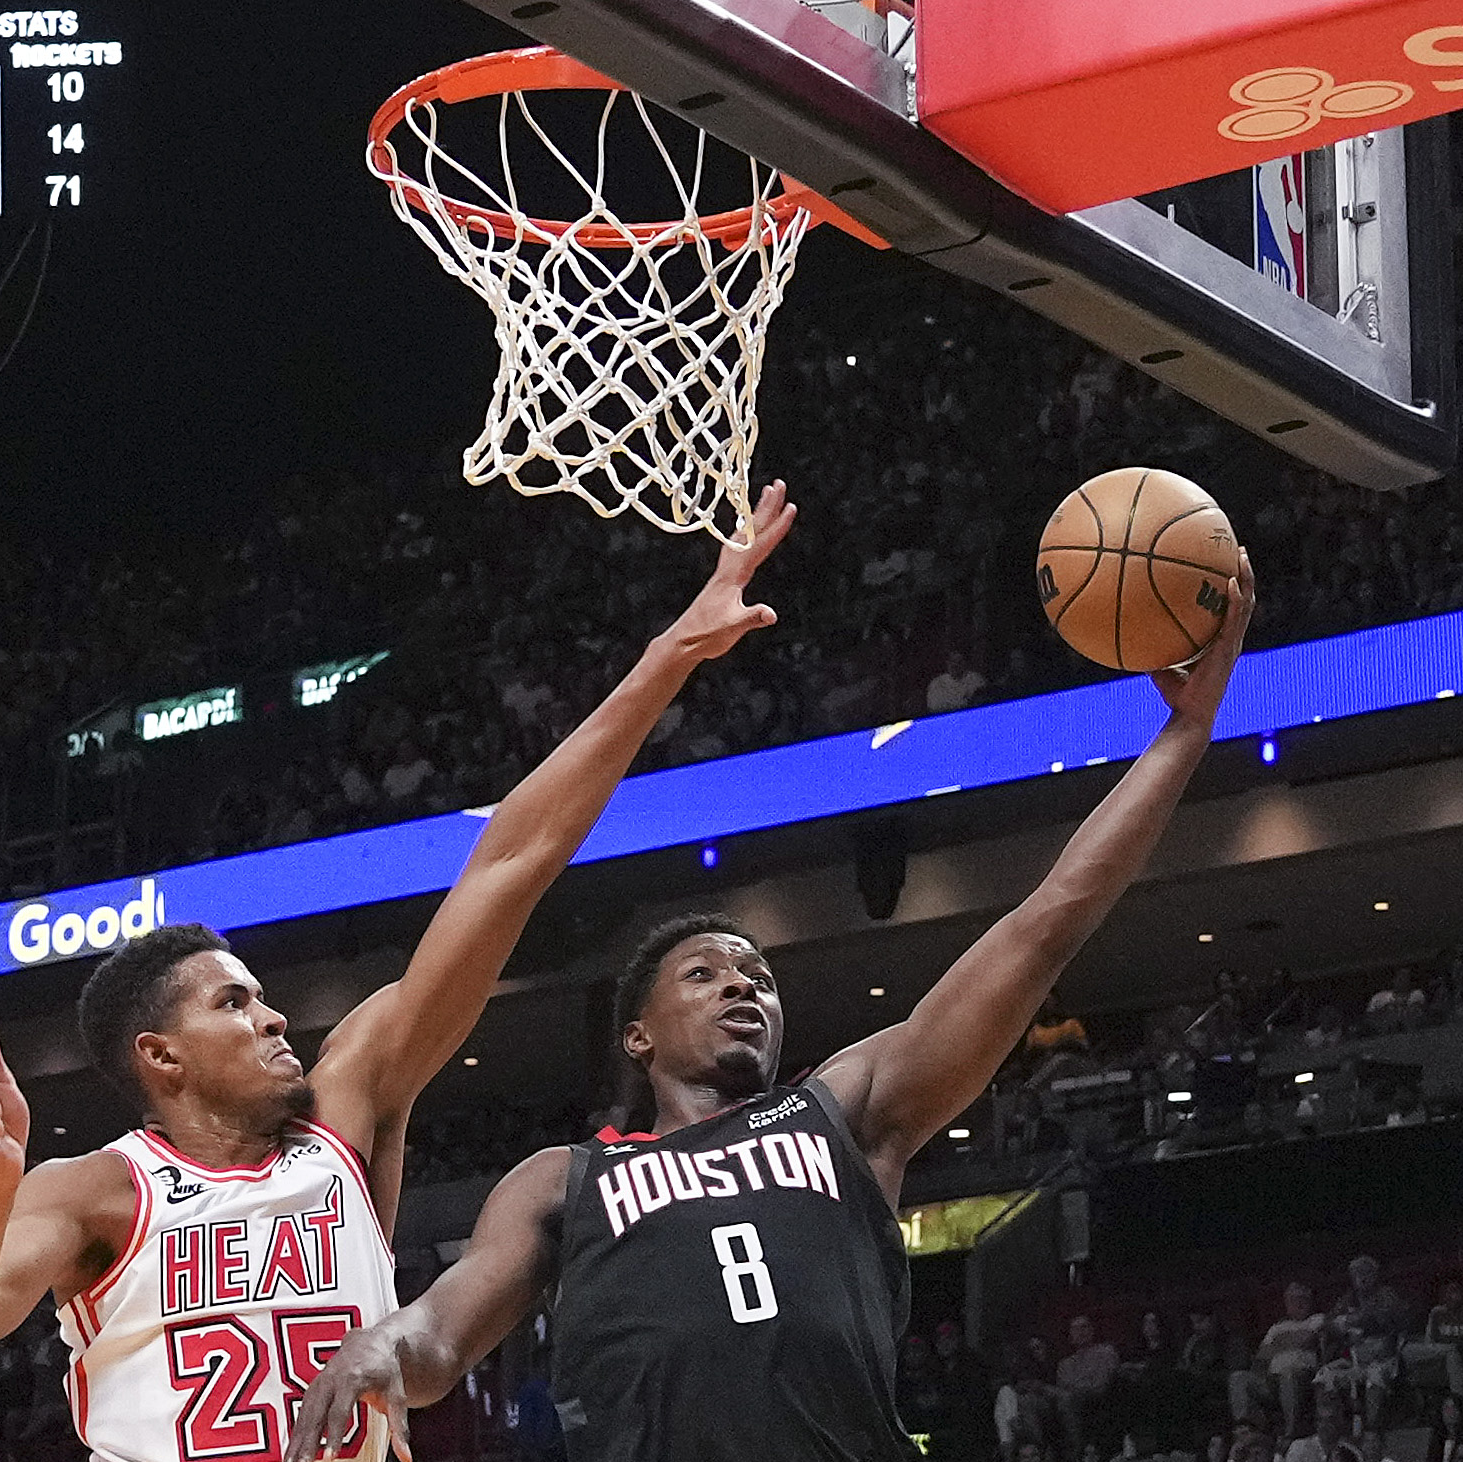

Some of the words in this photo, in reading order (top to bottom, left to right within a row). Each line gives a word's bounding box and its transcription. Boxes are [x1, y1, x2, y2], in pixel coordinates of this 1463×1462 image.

[47, 71, 85, 102] 10
[47, 123, 85, 154] 14
[45, 175, 82, 206] 71
[748, 1100, 808, 1129] karma
[749, 1094, 800, 1120] credit
[172, 1182, 206, 1195] NIKE
[597, 1130, 841, 1239] HOUSTON
[160, 1174, 344, 1316] HEAT
[711, 1222, 779, 1324] 8
